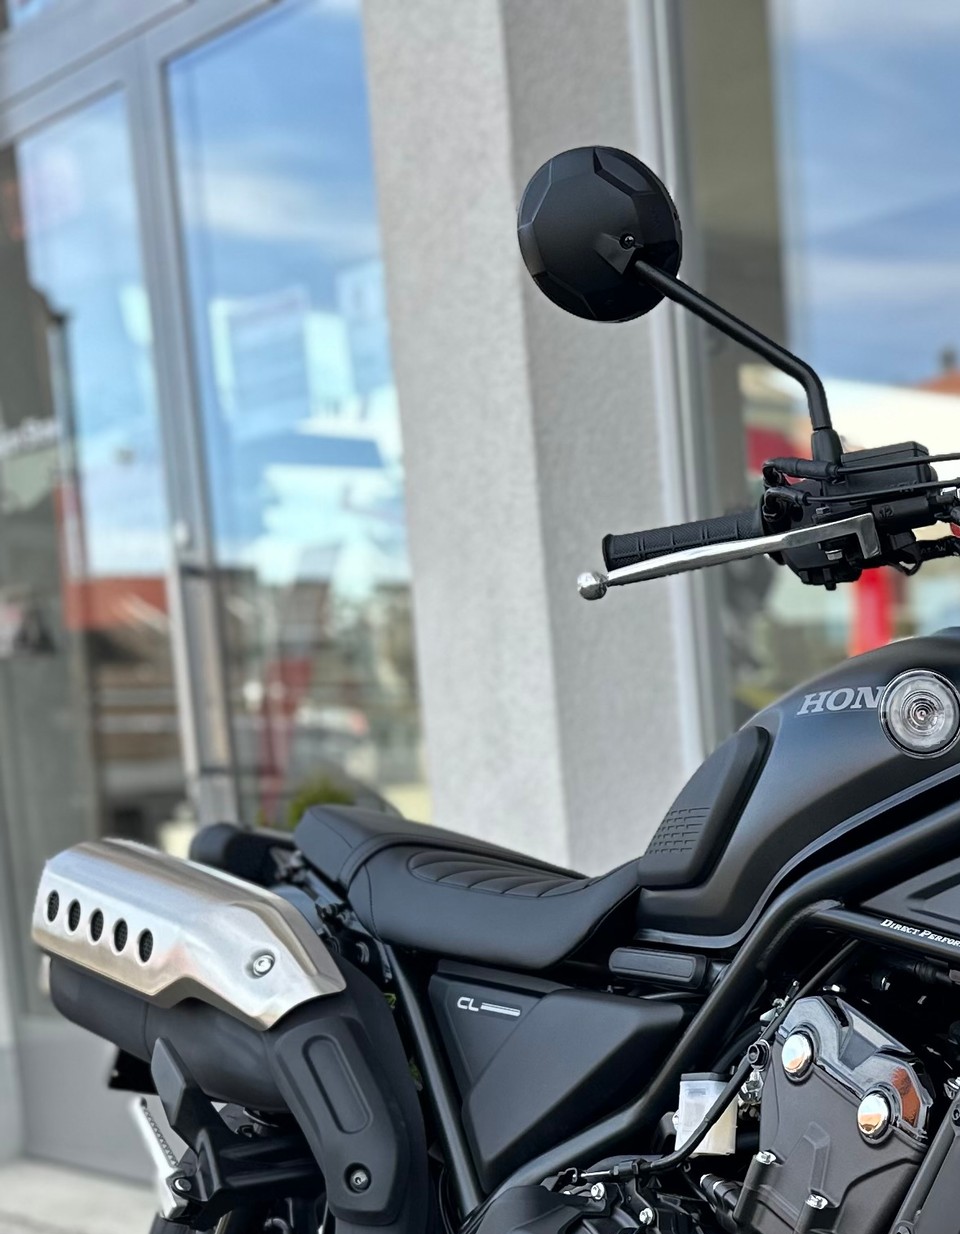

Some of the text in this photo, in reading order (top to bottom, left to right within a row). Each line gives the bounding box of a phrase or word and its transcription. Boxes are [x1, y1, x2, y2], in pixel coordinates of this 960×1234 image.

[796, 686, 886, 716] HON
[880, 919, 920, 936] DIRECT
[457, 996, 479, 1012] CL
